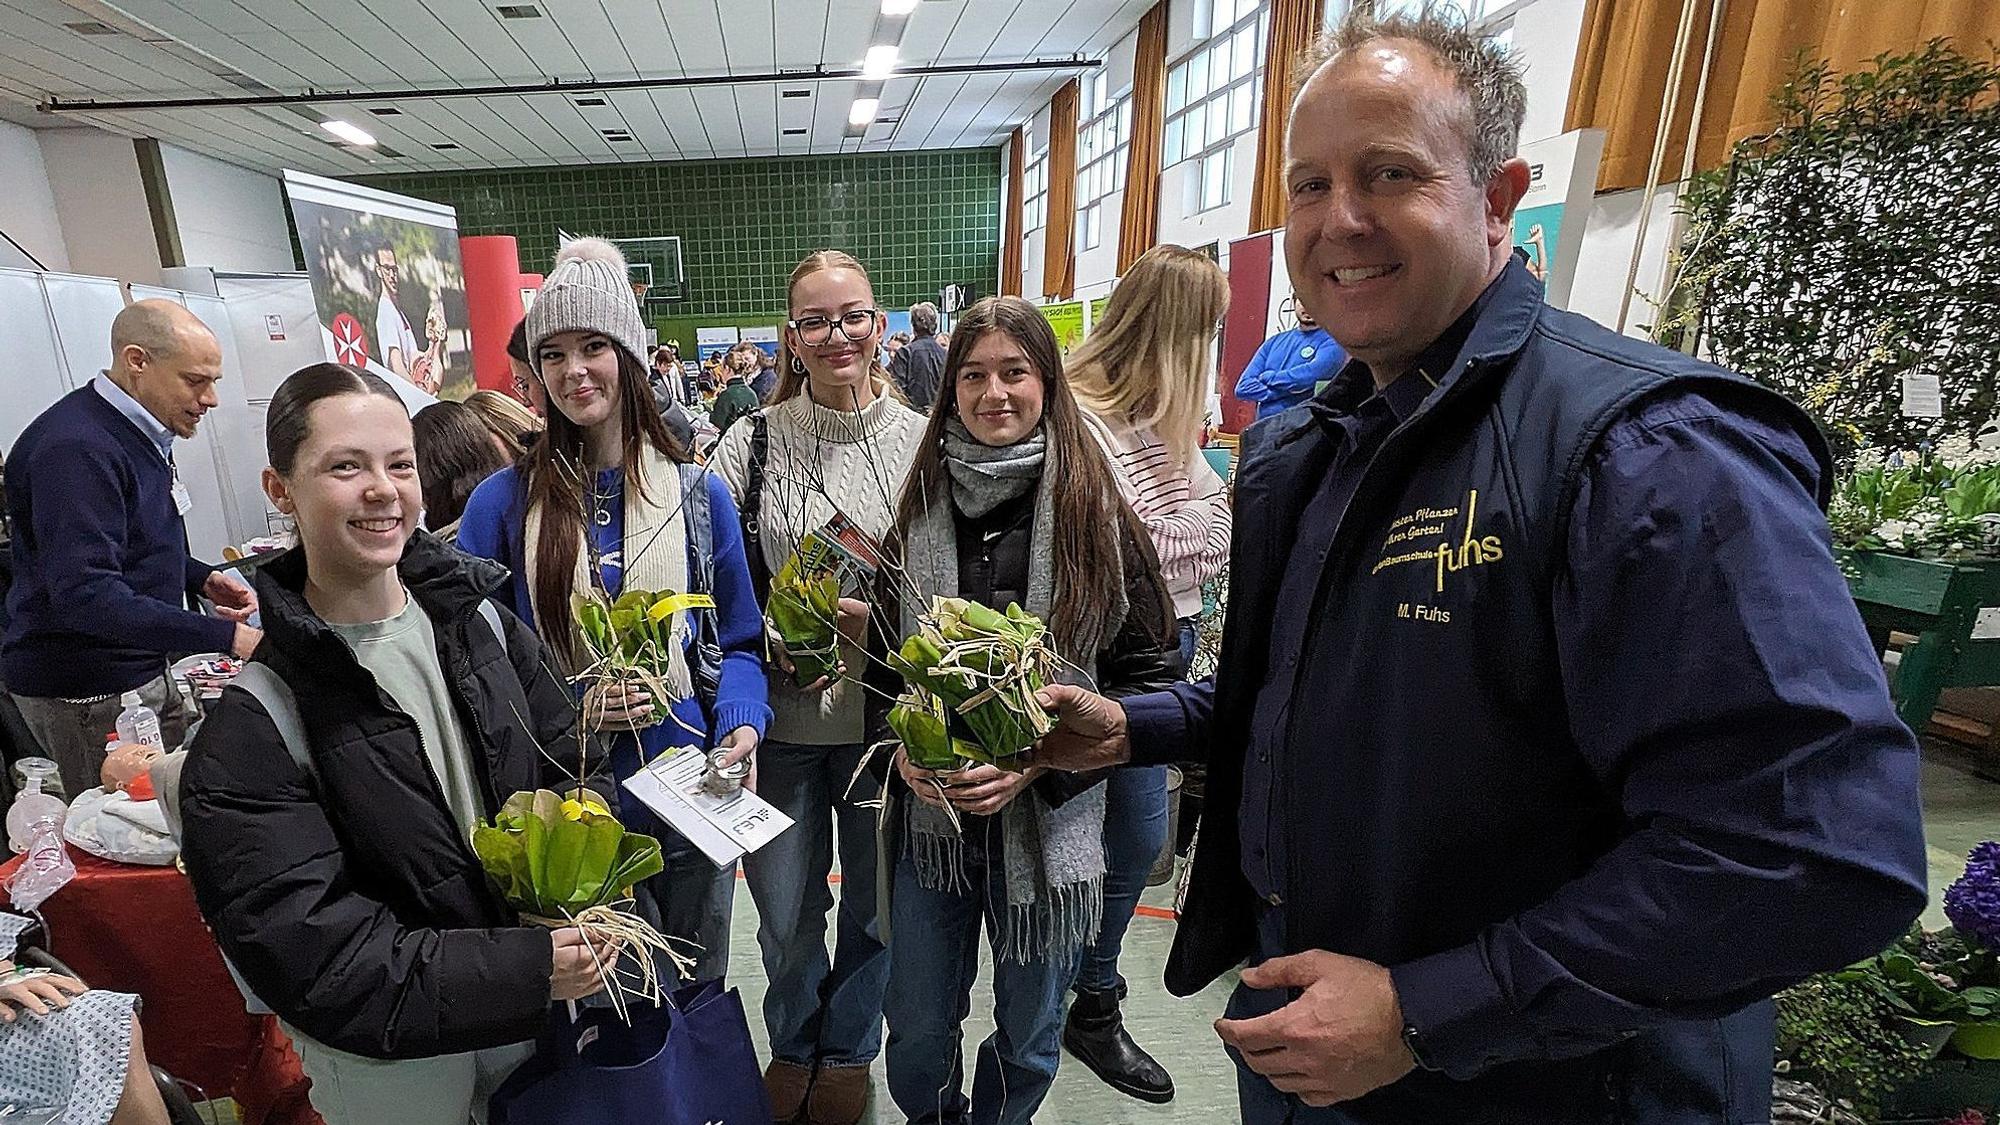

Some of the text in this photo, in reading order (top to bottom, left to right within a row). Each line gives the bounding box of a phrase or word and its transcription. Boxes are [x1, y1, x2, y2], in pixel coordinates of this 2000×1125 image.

[1415, 507, 1458, 522] Pflanzen
[1407, 521, 1445, 540] Garten!
[1434, 489, 1503, 592] fuhs
[1397, 603, 1450, 623] M. Fuhs
